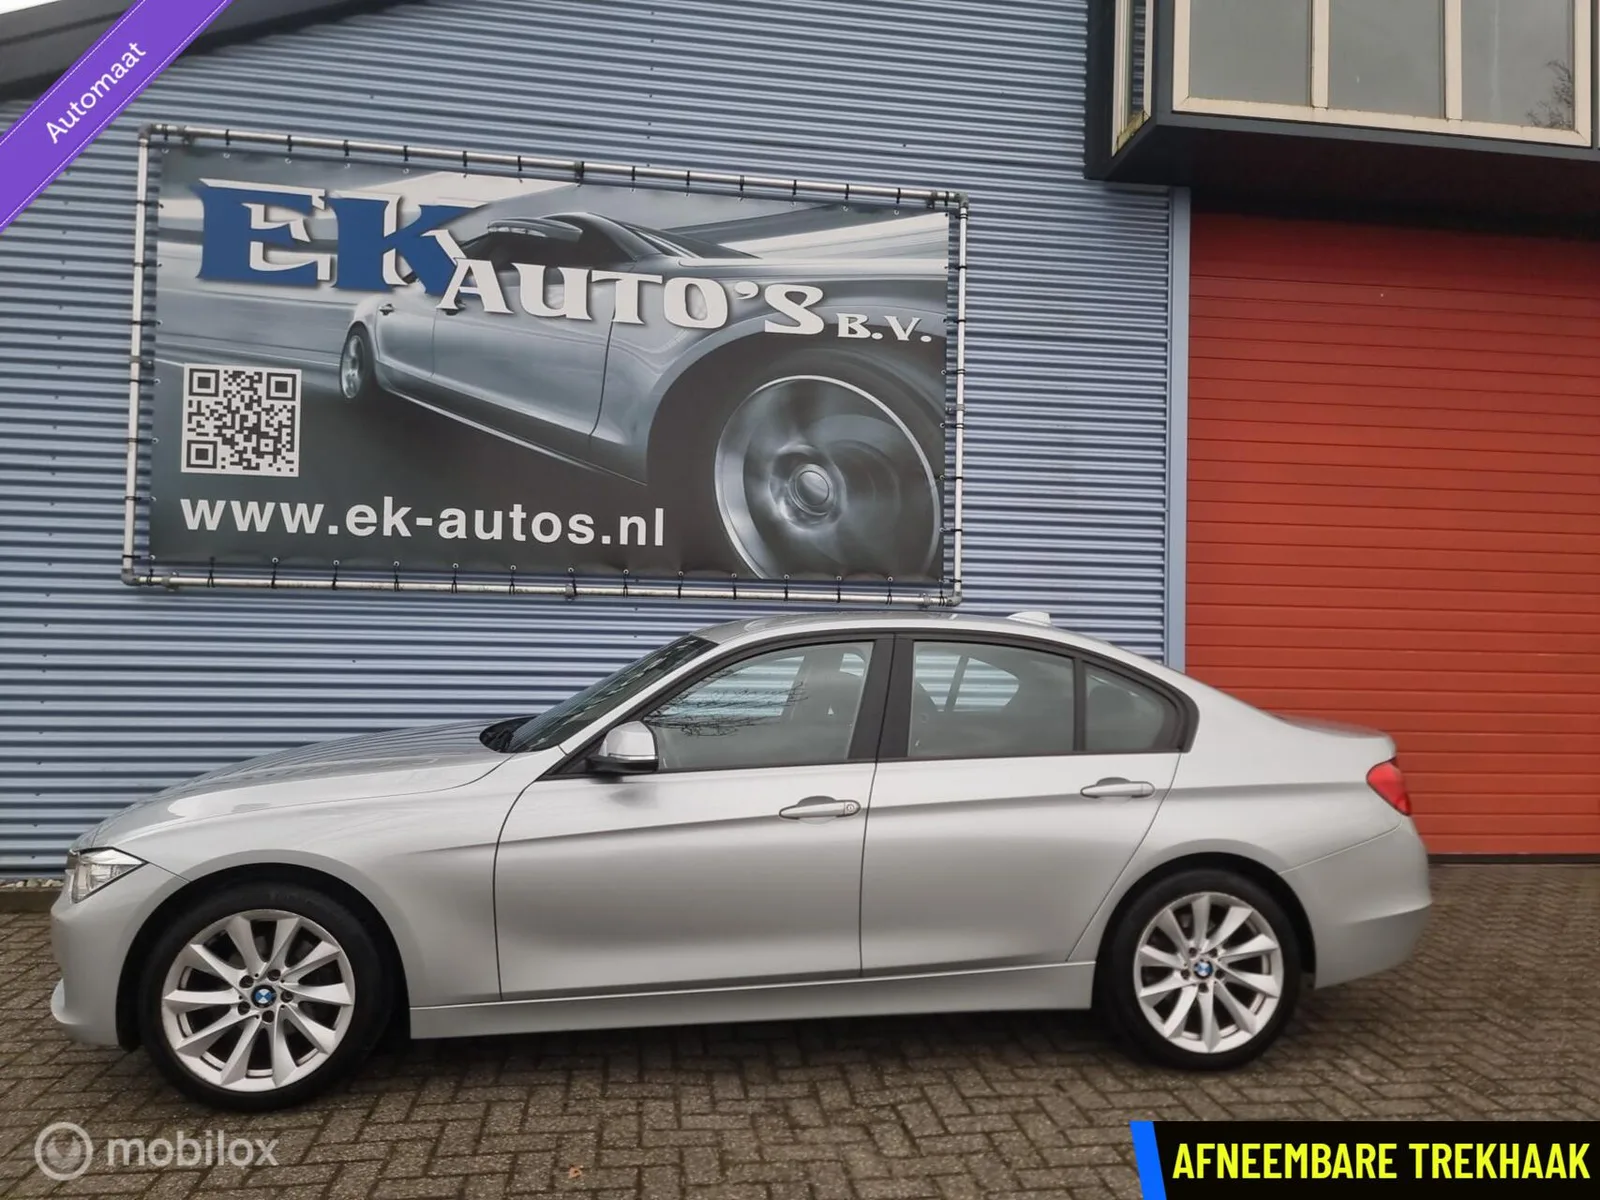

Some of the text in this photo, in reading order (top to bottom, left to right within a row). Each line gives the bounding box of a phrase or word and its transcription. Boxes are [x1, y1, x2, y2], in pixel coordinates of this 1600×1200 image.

[191, 178, 488, 297] EK
[836, 312, 933, 343] B.V.
[180, 496, 665, 547] www.ek-autos.nl
